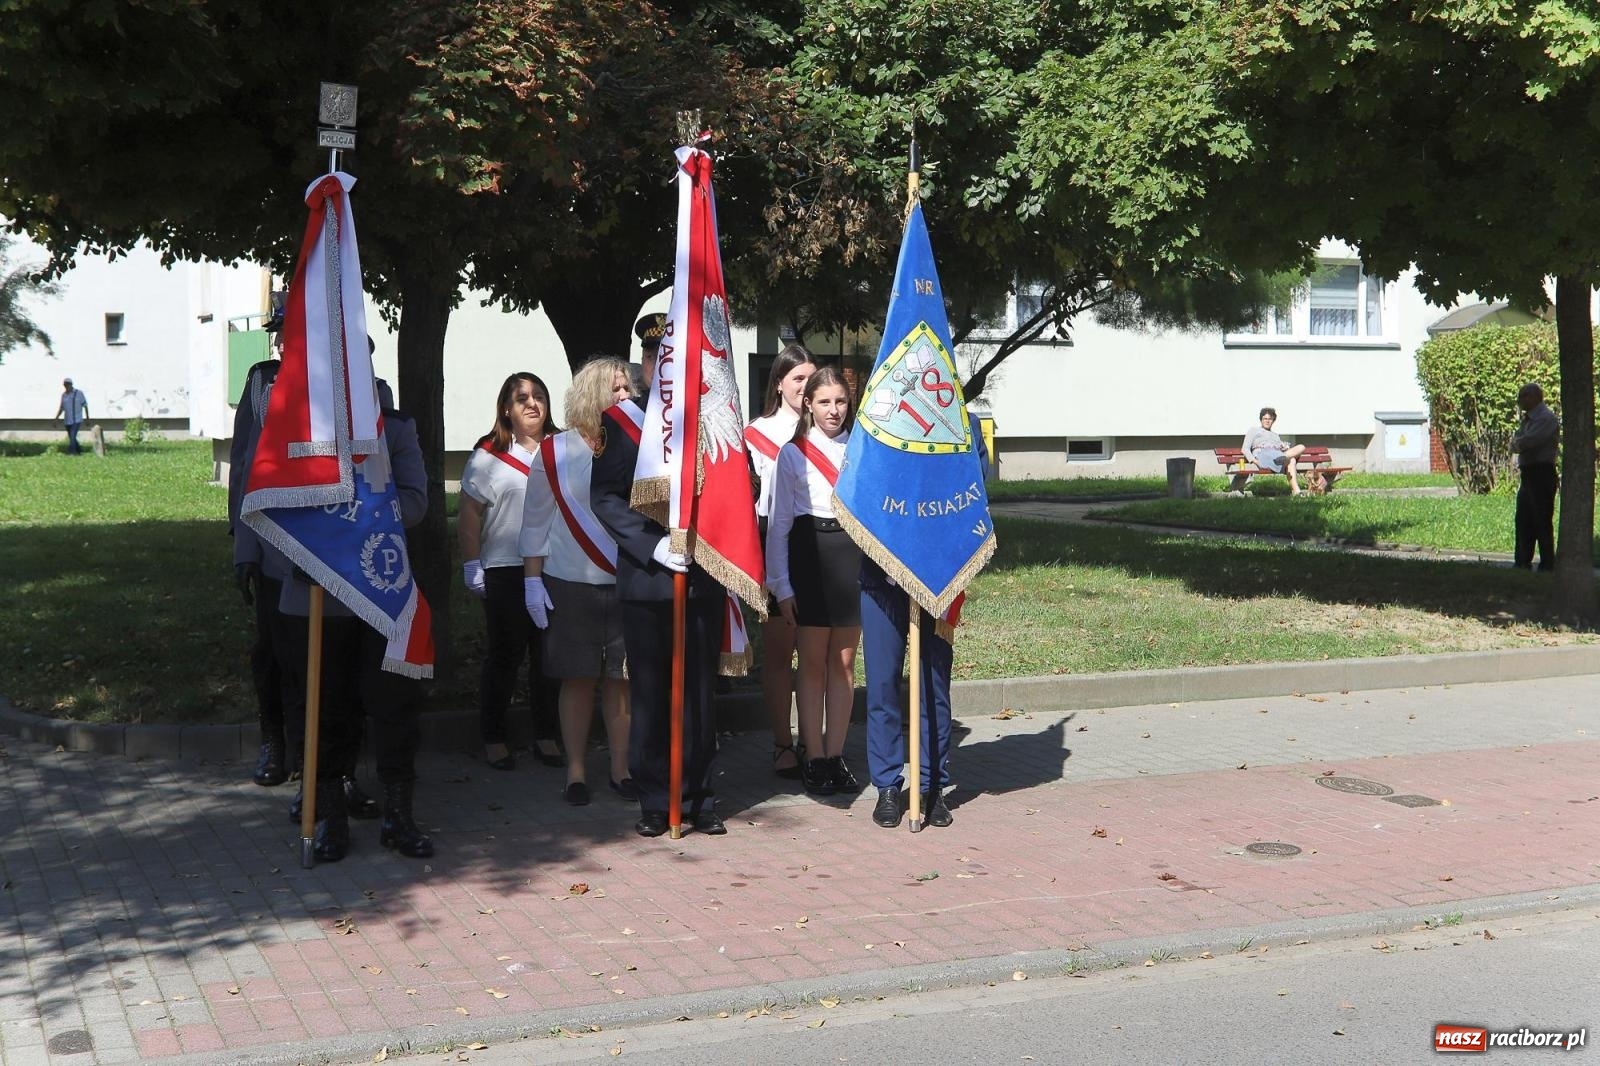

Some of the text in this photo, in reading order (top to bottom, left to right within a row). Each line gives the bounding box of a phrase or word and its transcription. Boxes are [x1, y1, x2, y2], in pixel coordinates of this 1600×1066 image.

[320, 134, 353, 145] POLICJA
[914, 278, 934, 296] NR
[882, 495, 909, 516] IM.
[382, 549, 398, 575] P
